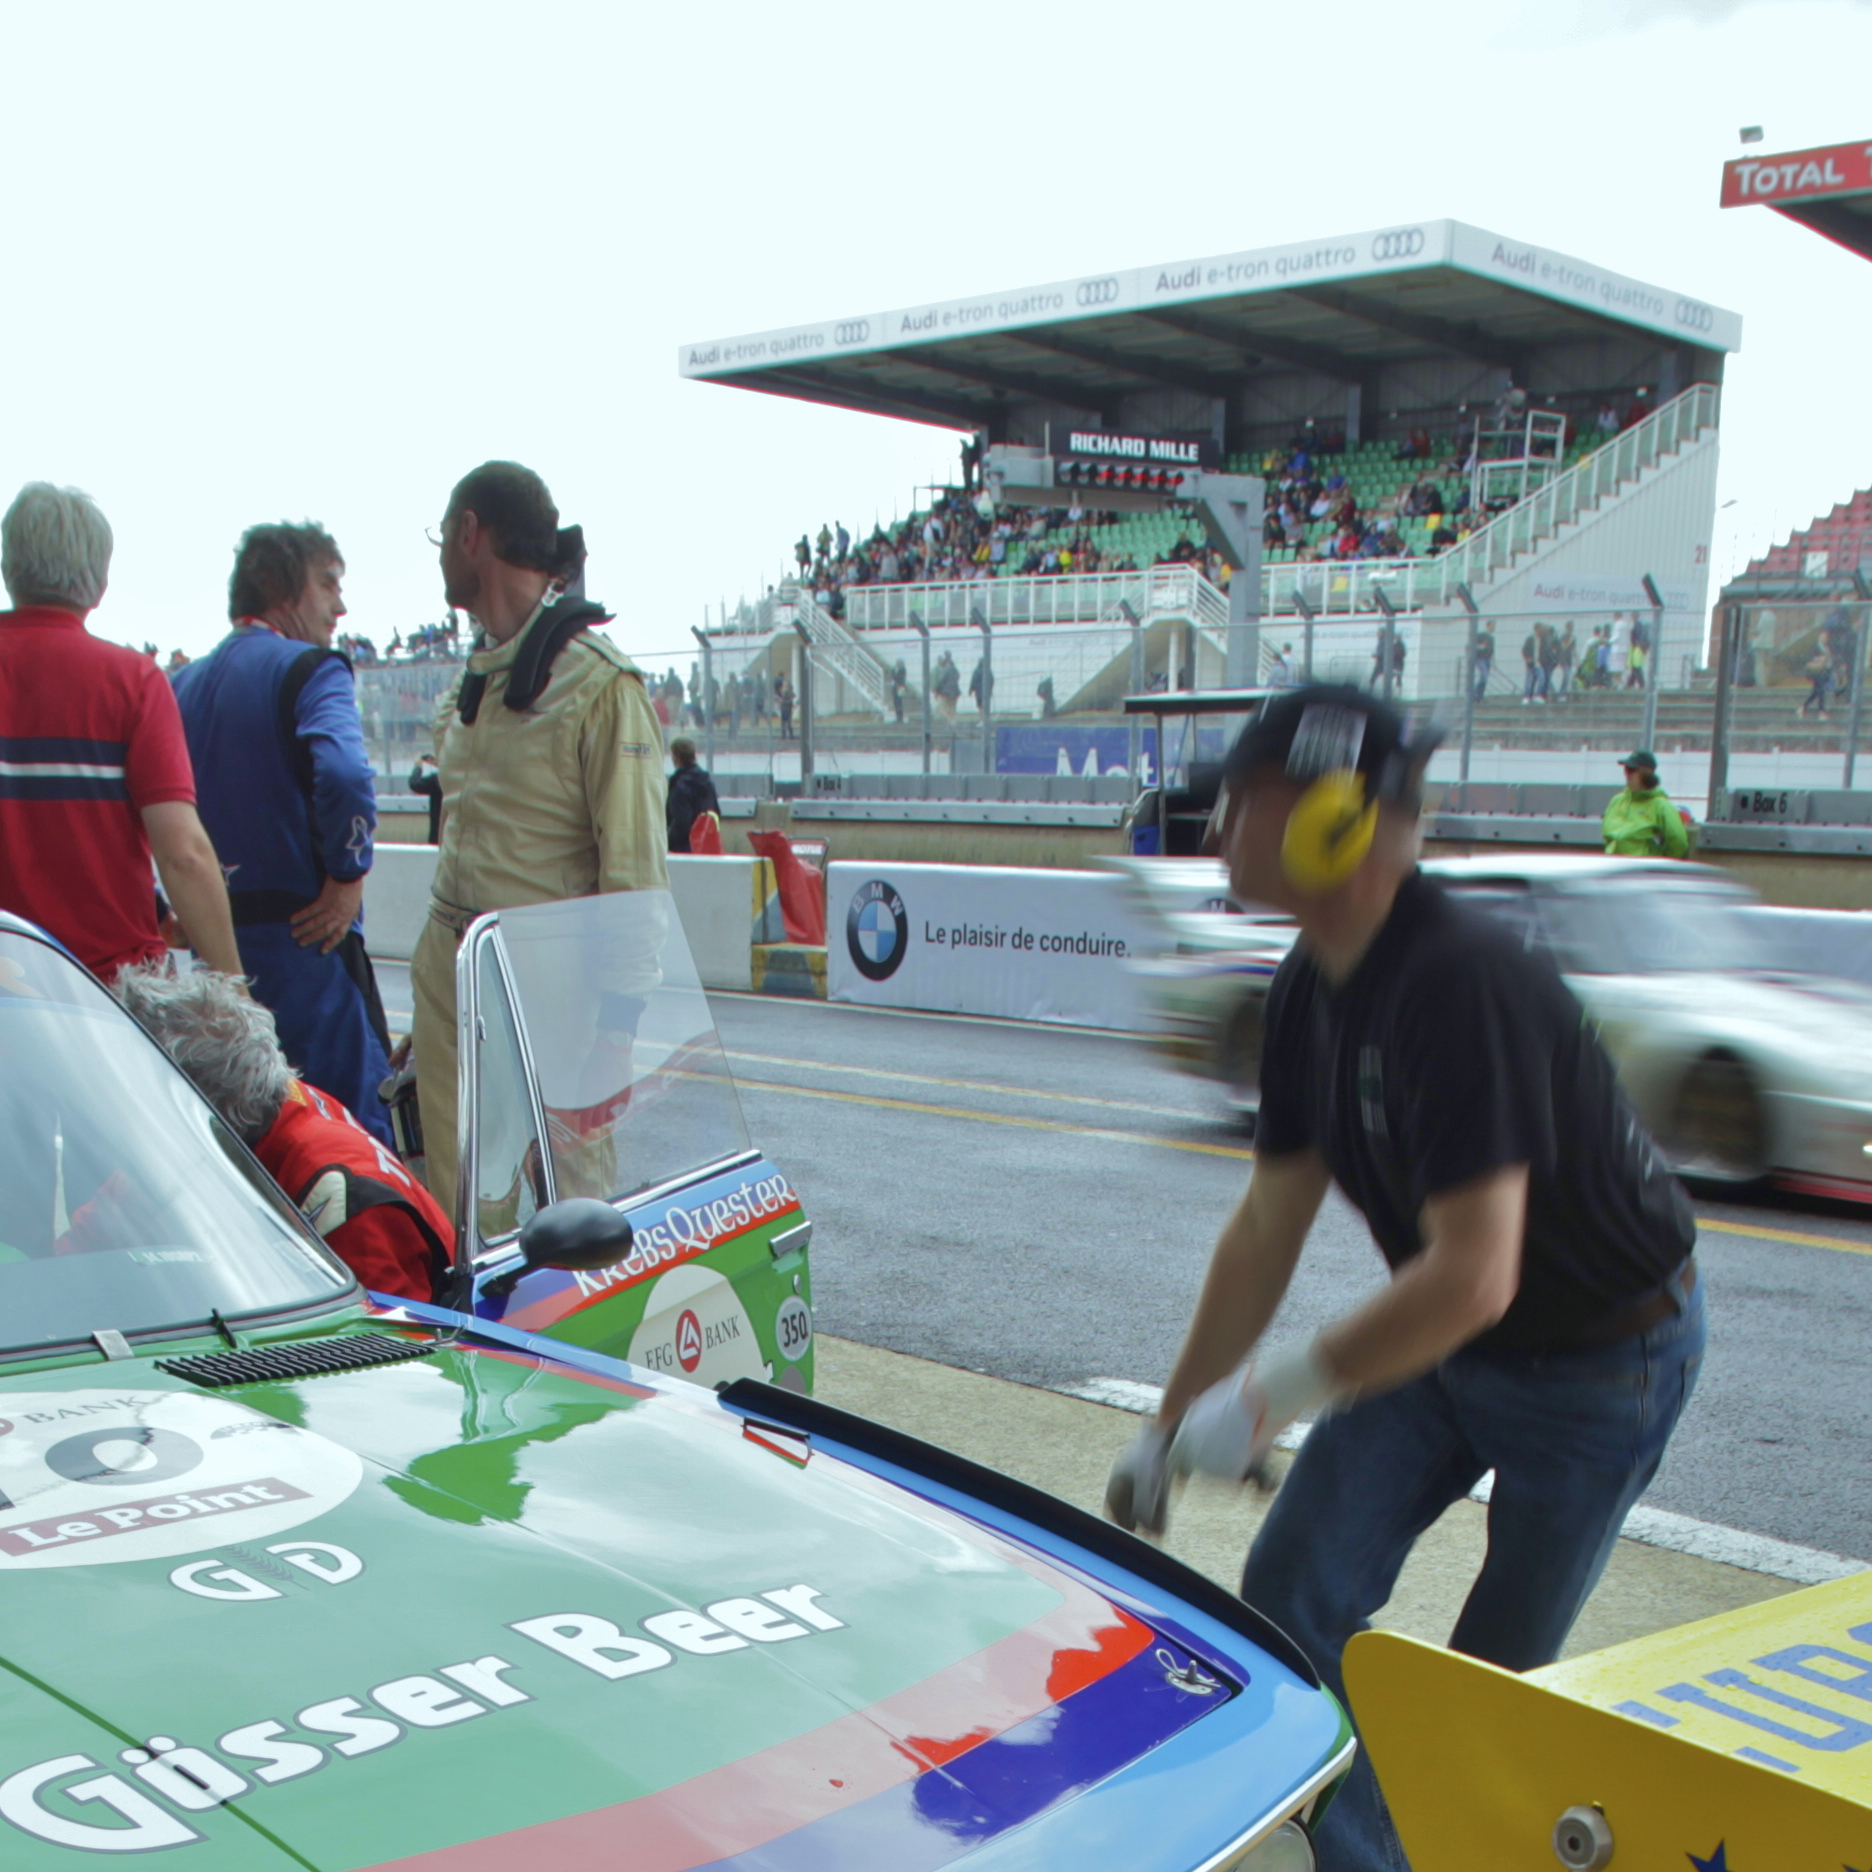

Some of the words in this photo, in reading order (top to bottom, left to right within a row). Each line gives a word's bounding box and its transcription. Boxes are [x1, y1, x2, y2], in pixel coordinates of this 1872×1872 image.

[1735, 157, 1843, 196] TOTAL
[1156, 269, 1201, 292] Audi
[1207, 259, 1269, 284] e-tron
[1276, 245, 1355, 277] quattro
[1493, 243, 1536, 274] Audi
[1541, 261, 1596, 292] e-tron
[1599, 281, 1664, 316] quattro
[901, 311, 938, 333] Audi
[942, 303, 994, 325] e-tron
[998, 289, 1064, 321] quattro
[689, 347, 719, 364] Audi
[723, 342, 765, 360] e-tron
[769, 333, 824, 357] quattro
[1070, 431, 1145, 458] RICHARD
[1150, 439, 1198, 462] MILLE
[1753, 791, 1776, 813] Box
[1779, 793, 1787, 813] 6
[925, 920, 946, 944] Le
[951, 924, 1005, 949] plaisir
[1011, 927, 1034, 950] de
[1040, 930, 1131, 958] conduire.
[645, 1343, 672, 1370] EFG
[705, 1315, 741, 1350] BANK
[25, 1395, 148, 1426] BANK
[8, 1514, 101, 1549] Le
[98, 1483, 283, 1532] Point
[506, 1583, 850, 1680] Beer
